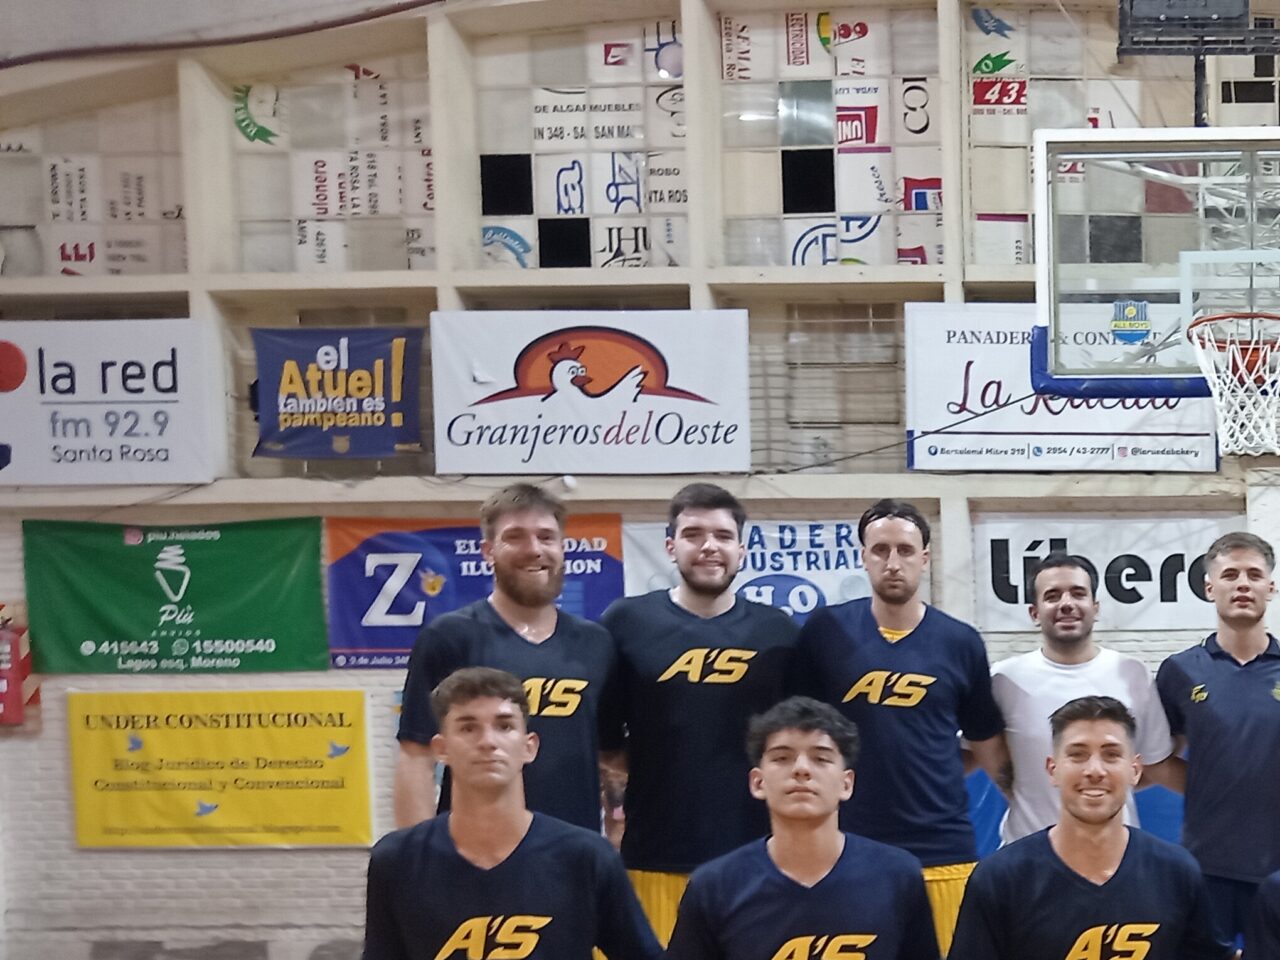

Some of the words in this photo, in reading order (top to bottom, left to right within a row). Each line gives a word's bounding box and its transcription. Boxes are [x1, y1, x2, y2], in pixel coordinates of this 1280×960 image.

[316, 337, 349, 371] el
[38, 347, 76, 395] la
[100, 347, 179, 395] red
[362, 397, 385, 412] es
[50, 411, 91, 438] fm
[103, 410, 170, 438] 92.9
[279, 412, 385, 431] pampeano
[51, 444, 113, 464] Santa
[120, 445, 170, 463] Rosa
[361, 552, 426, 627] Z
[657, 647, 759, 685] A'S
[842, 670, 938, 708] A'S
[84, 713, 164, 731] UNDER
[165, 711, 353, 730] CONSTITUCIONAL
[113, 757, 150, 772] Blog
[230, 757, 248, 769] de
[254, 756, 324, 770] Derecho
[94, 777, 214, 792] Constitucional
[233, 776, 346, 790] Convencional
